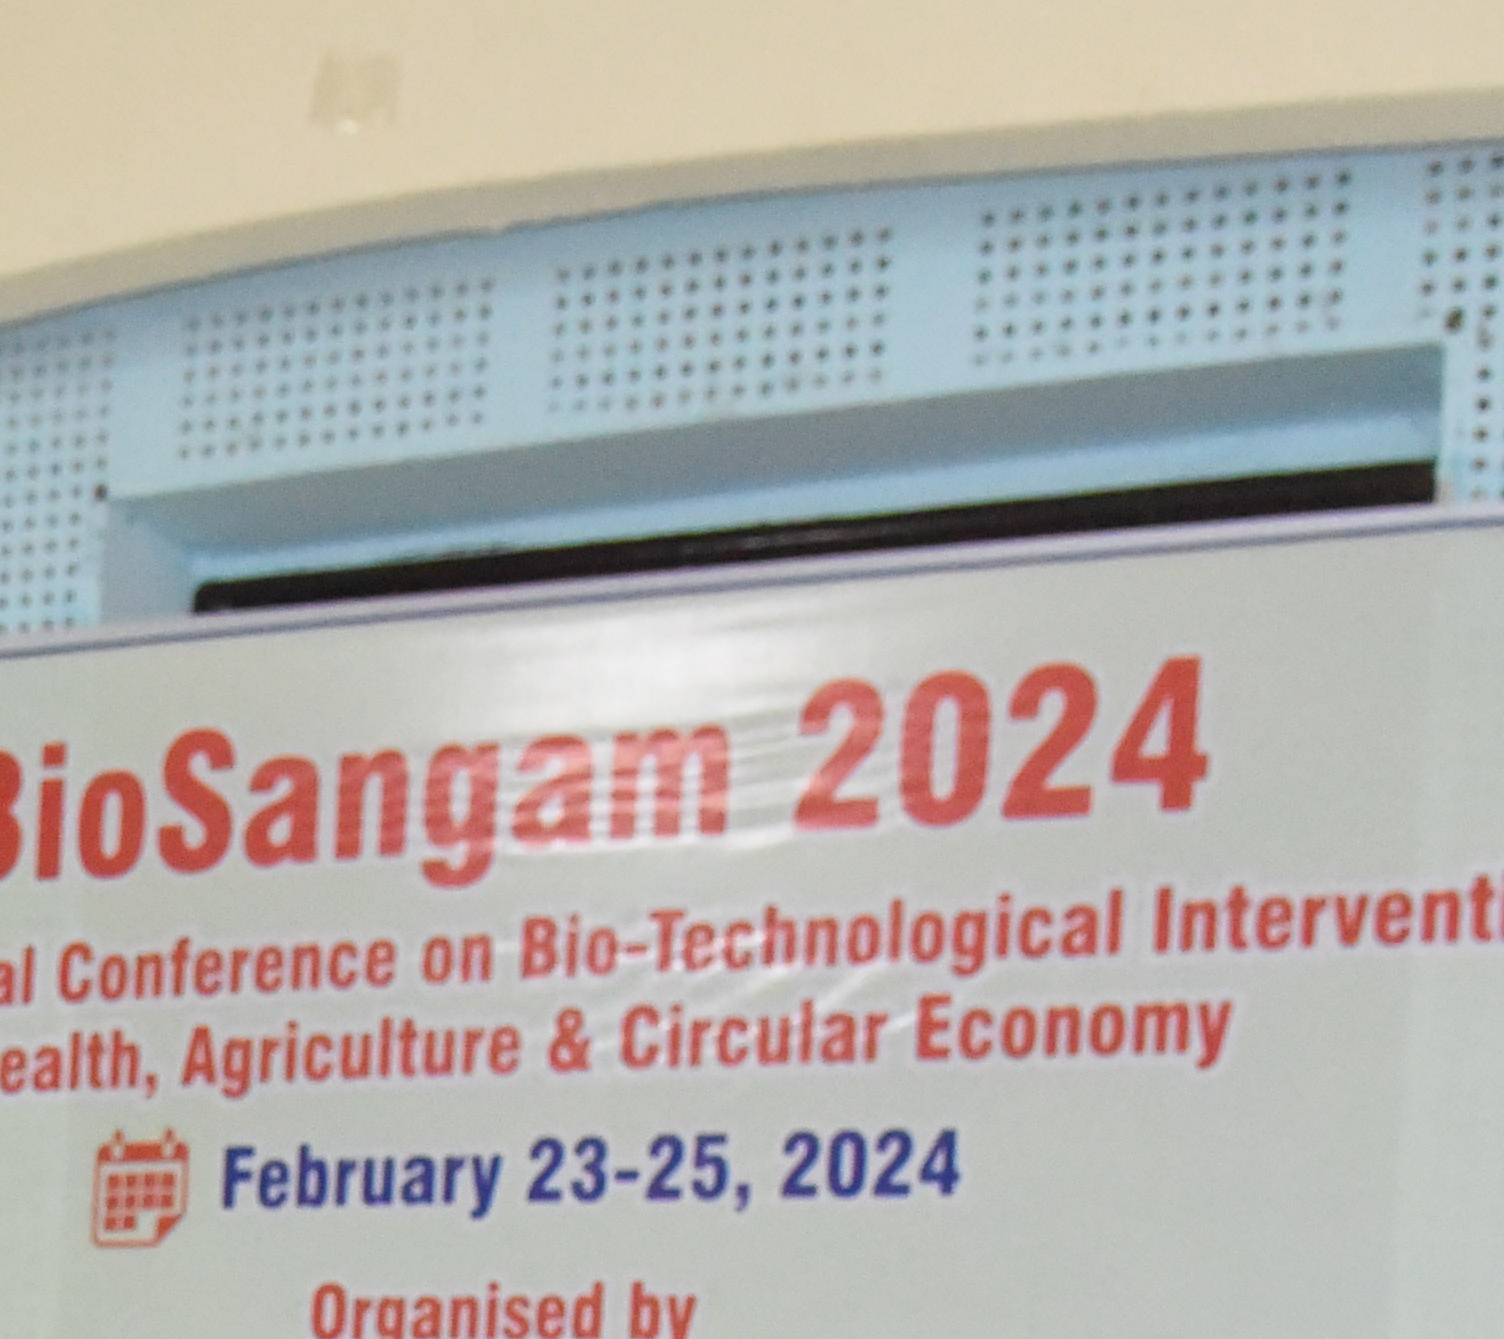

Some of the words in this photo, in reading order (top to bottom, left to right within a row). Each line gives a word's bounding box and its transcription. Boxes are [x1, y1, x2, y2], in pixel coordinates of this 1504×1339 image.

[791, 655, 1210, 832] 2024
[56, 936, 398, 1005] Conference
[420, 934, 494, 986] on
[519, 887, 1125, 981] Bio-Technological
[180, 1016, 522, 1100] Agriculture
[546, 1007, 592, 1074] &
[619, 998, 890, 1071] Circular
[914, 992, 1234, 1070] Economy
[223, 1144, 503, 1221] February
[527, 1134, 753, 1212] 23-25,
[781, 1130, 962, 1202] 2024
